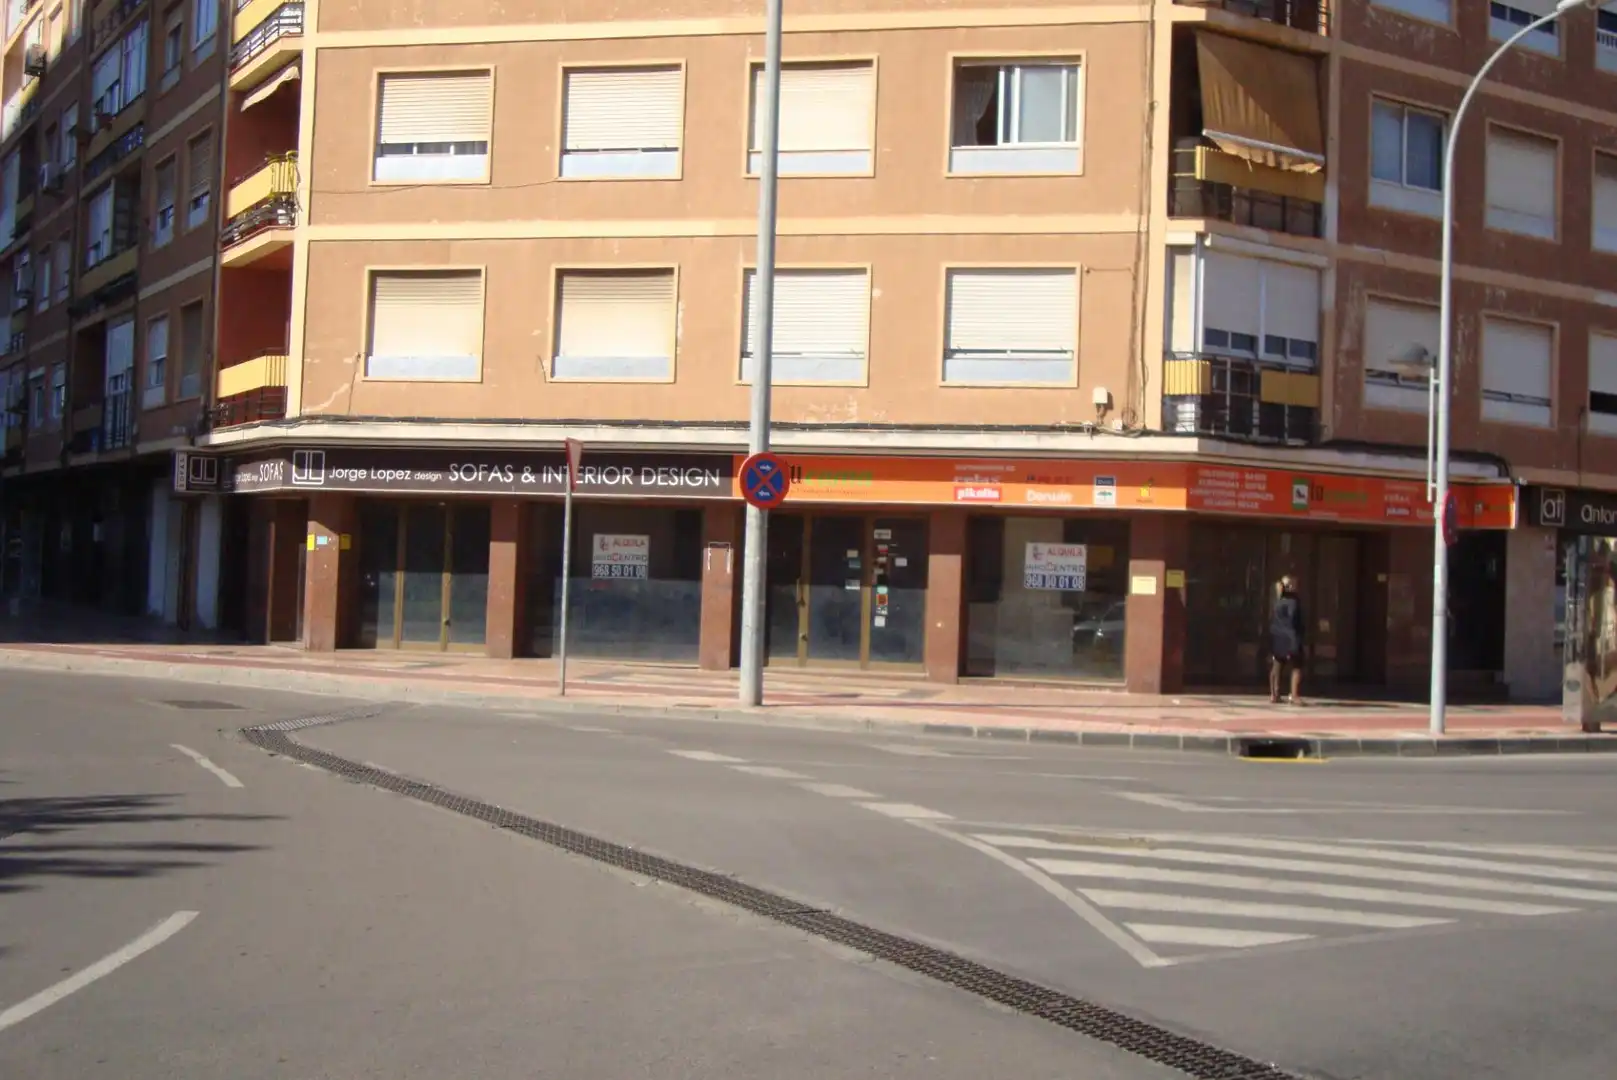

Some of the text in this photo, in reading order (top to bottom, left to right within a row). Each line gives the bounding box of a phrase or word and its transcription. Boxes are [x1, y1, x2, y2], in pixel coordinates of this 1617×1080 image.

[259, 461, 284, 482] SOFAS
[329, 468, 367, 482] Jorge
[371, 469, 411, 482] Lopez
[414, 471, 442, 481] design
[448, 463, 514, 483] SOFAS
[521, 465, 536, 484] &
[543, 465, 633, 485] INERIOR
[641, 466, 720, 487] DESIGN
[623, 565, 634, 578] 01
[1059, 575, 1069, 589] 01
